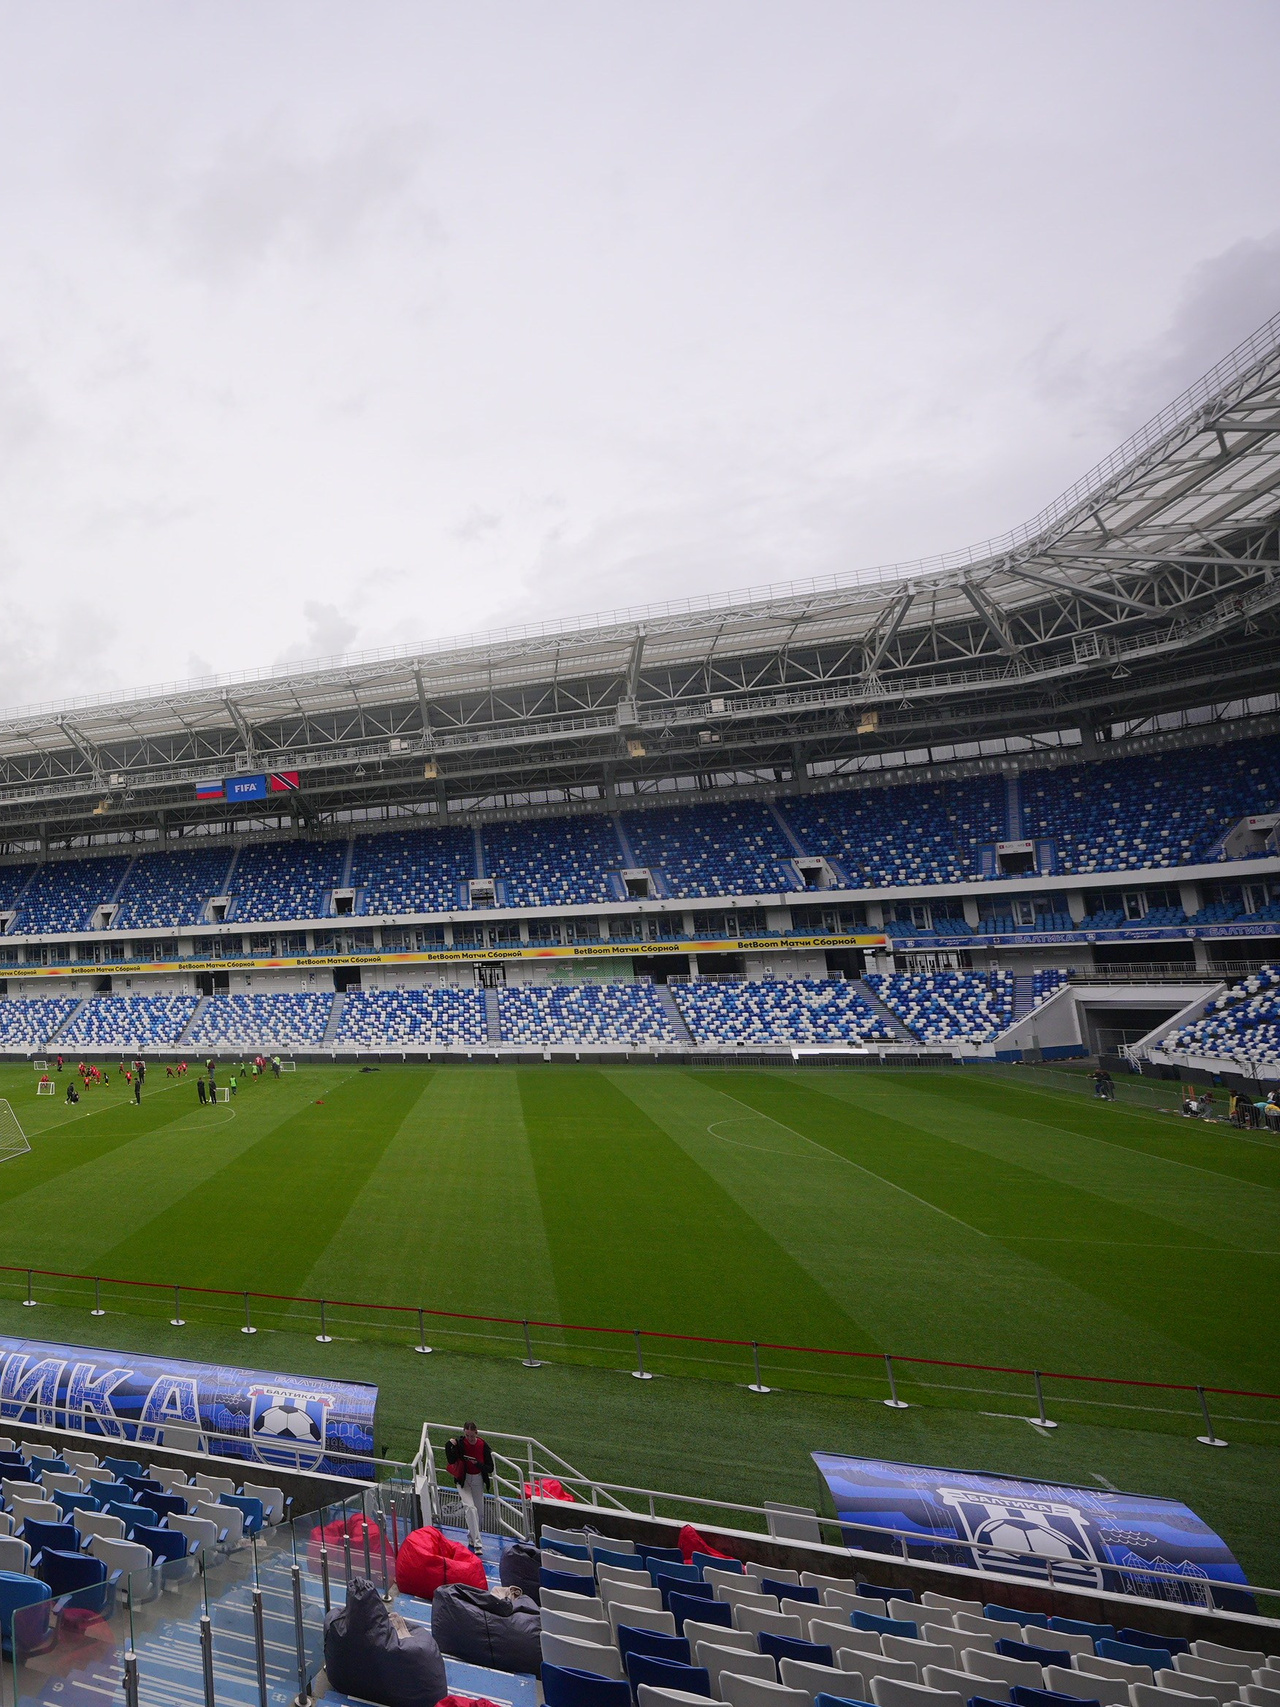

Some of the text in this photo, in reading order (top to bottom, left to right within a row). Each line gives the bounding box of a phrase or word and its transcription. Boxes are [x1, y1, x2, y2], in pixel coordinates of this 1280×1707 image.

[235, 784, 256, 792] FIFA
[266, 1389, 316, 1400] БАЛТИКА
[967, 1494, 1051, 1512] БАЛТИКА
